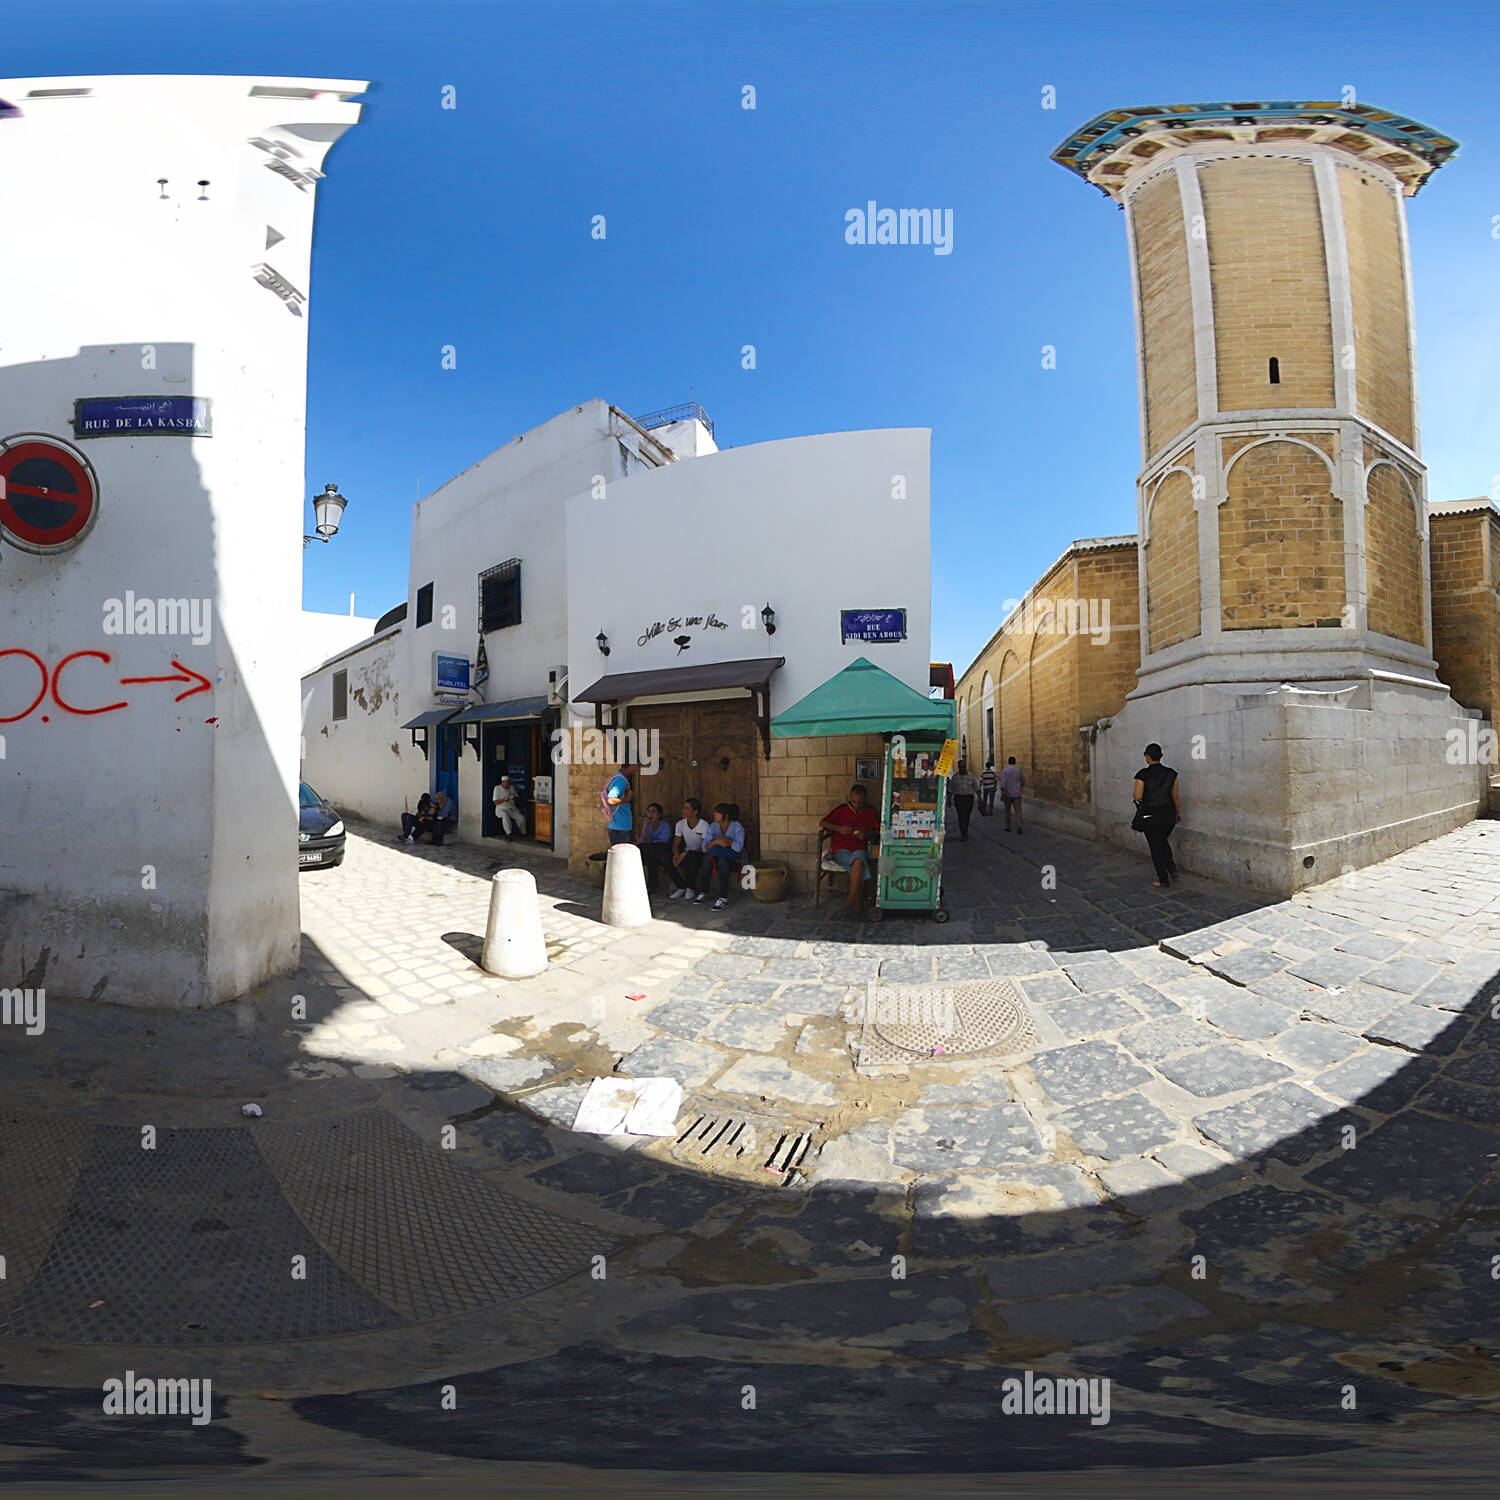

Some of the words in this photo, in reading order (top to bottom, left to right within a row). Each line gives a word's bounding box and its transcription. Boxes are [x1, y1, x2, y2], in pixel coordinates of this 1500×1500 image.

[85, 419, 110, 429] RUE
[116, 418, 132, 428] DE
[138, 418, 153, 427] LA
[158, 418, 201, 428] KASBA
[879, 631, 903, 639] AROUS
[438, 680, 468, 688] PUBLITEL
